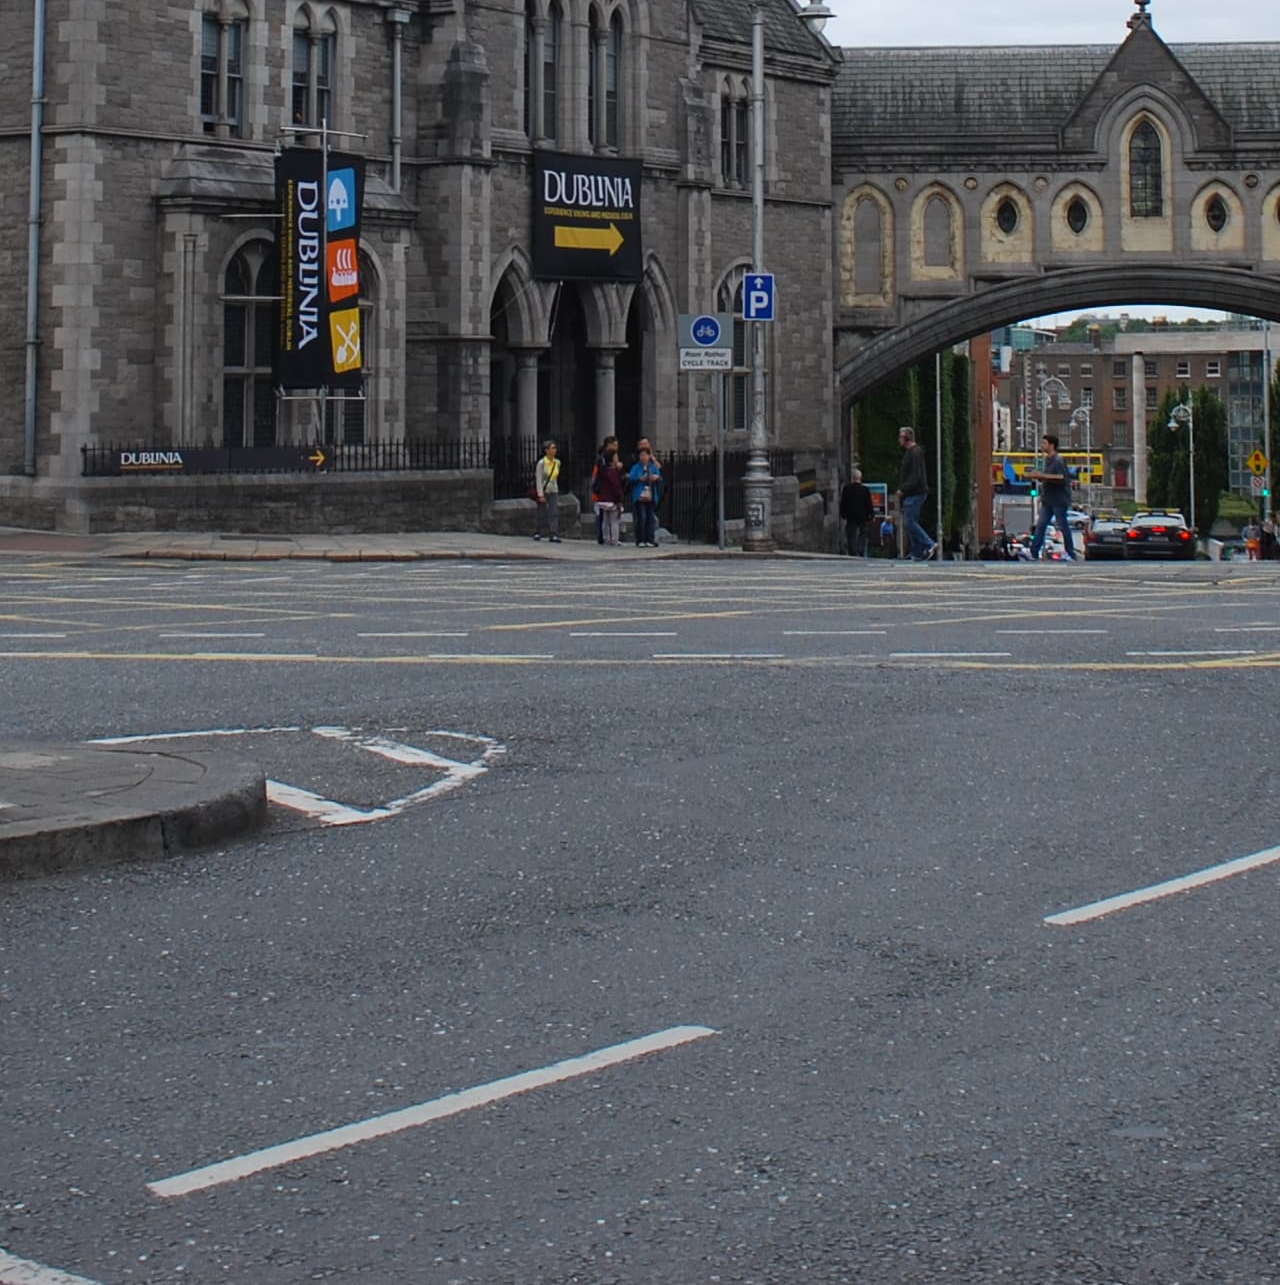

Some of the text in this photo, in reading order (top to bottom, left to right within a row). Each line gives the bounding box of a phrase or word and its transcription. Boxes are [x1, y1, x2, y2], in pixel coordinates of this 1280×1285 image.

[543, 169, 634, 209] DUBLINIA
[297, 180, 319, 350] DUBLINIA
[750, 291, 769, 317] P
[682, 359, 729, 367] CYCLE TRACK
[120, 452, 183, 464] DUBLINIA
